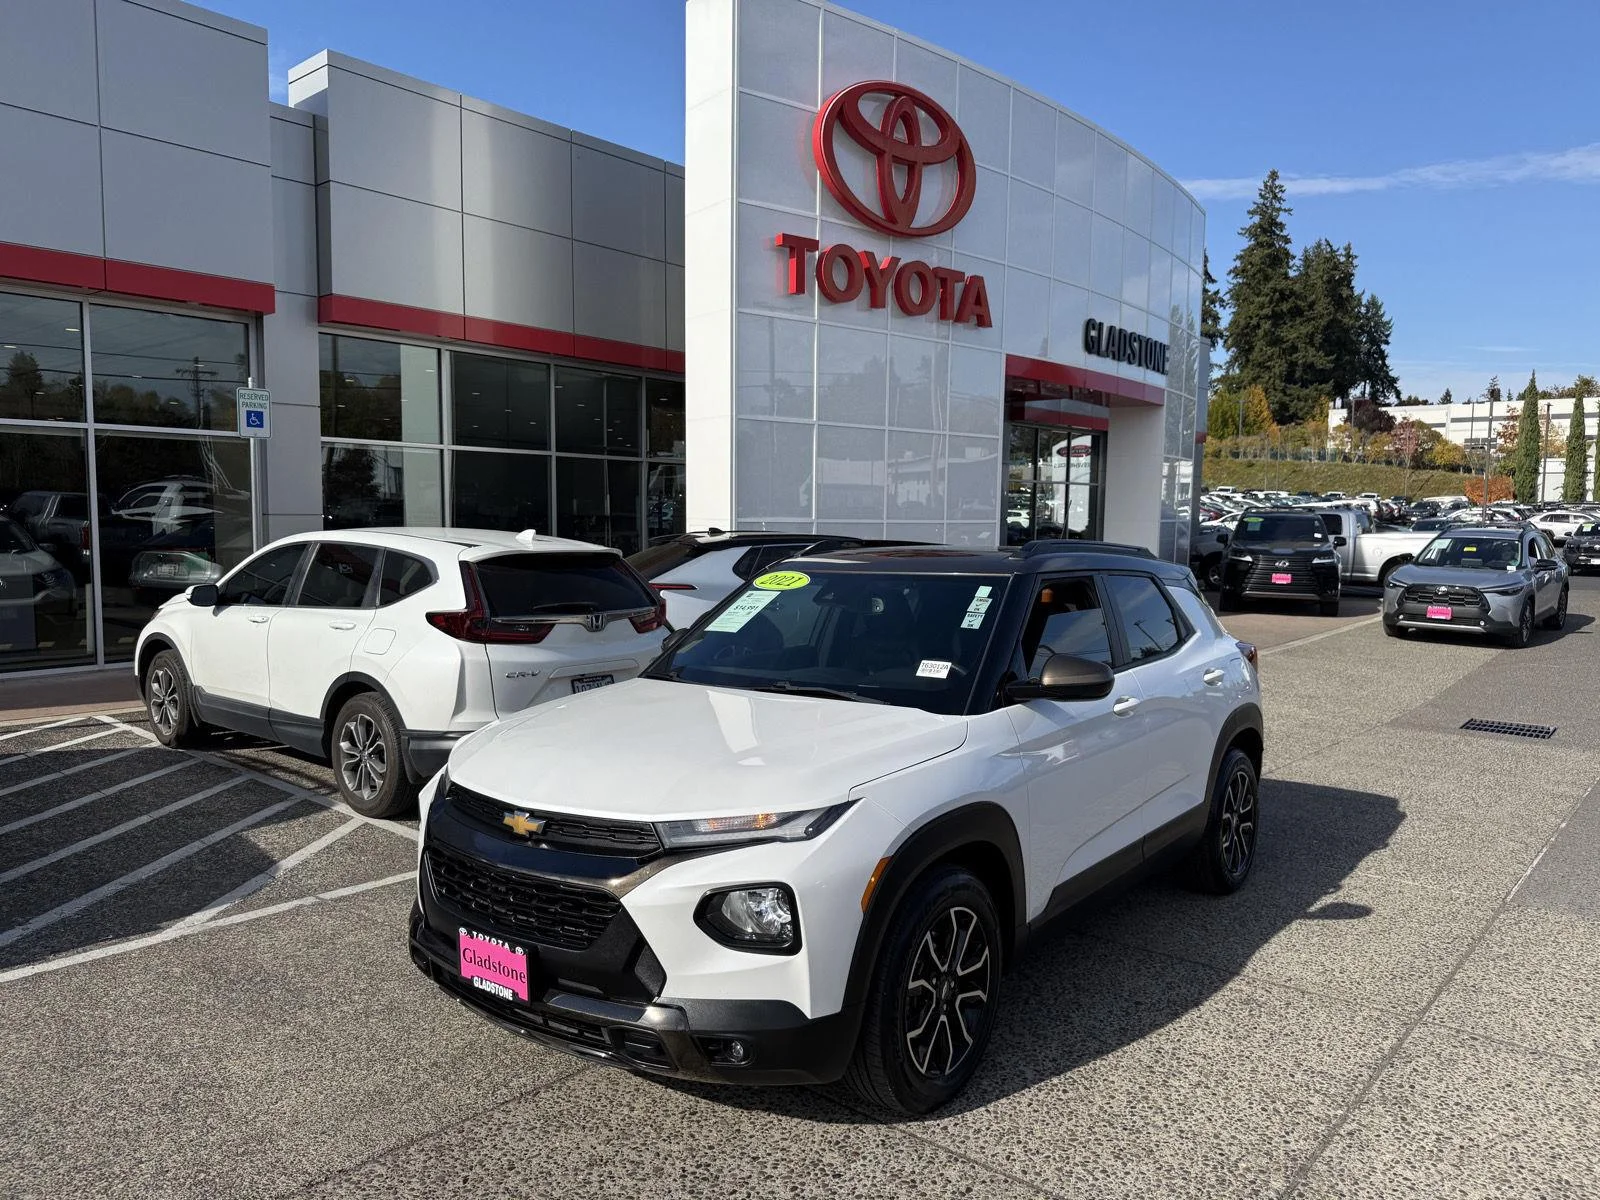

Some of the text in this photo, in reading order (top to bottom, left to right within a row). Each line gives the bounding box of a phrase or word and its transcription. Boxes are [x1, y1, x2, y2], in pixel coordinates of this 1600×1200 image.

[774, 232, 993, 328] TOYOTA
[1084, 318, 1169, 376] GLADSTONE
[240, 392, 269, 401] RESERVED
[241, 401, 268, 409] PARKING
[759, 574, 804, 587] 2021
[505, 670, 541, 679] CR-V
[472, 930, 510, 951] TOYOTA
[462, 947, 527, 984] Gladstone
[473, 976, 513, 1000] GLADSTONE
